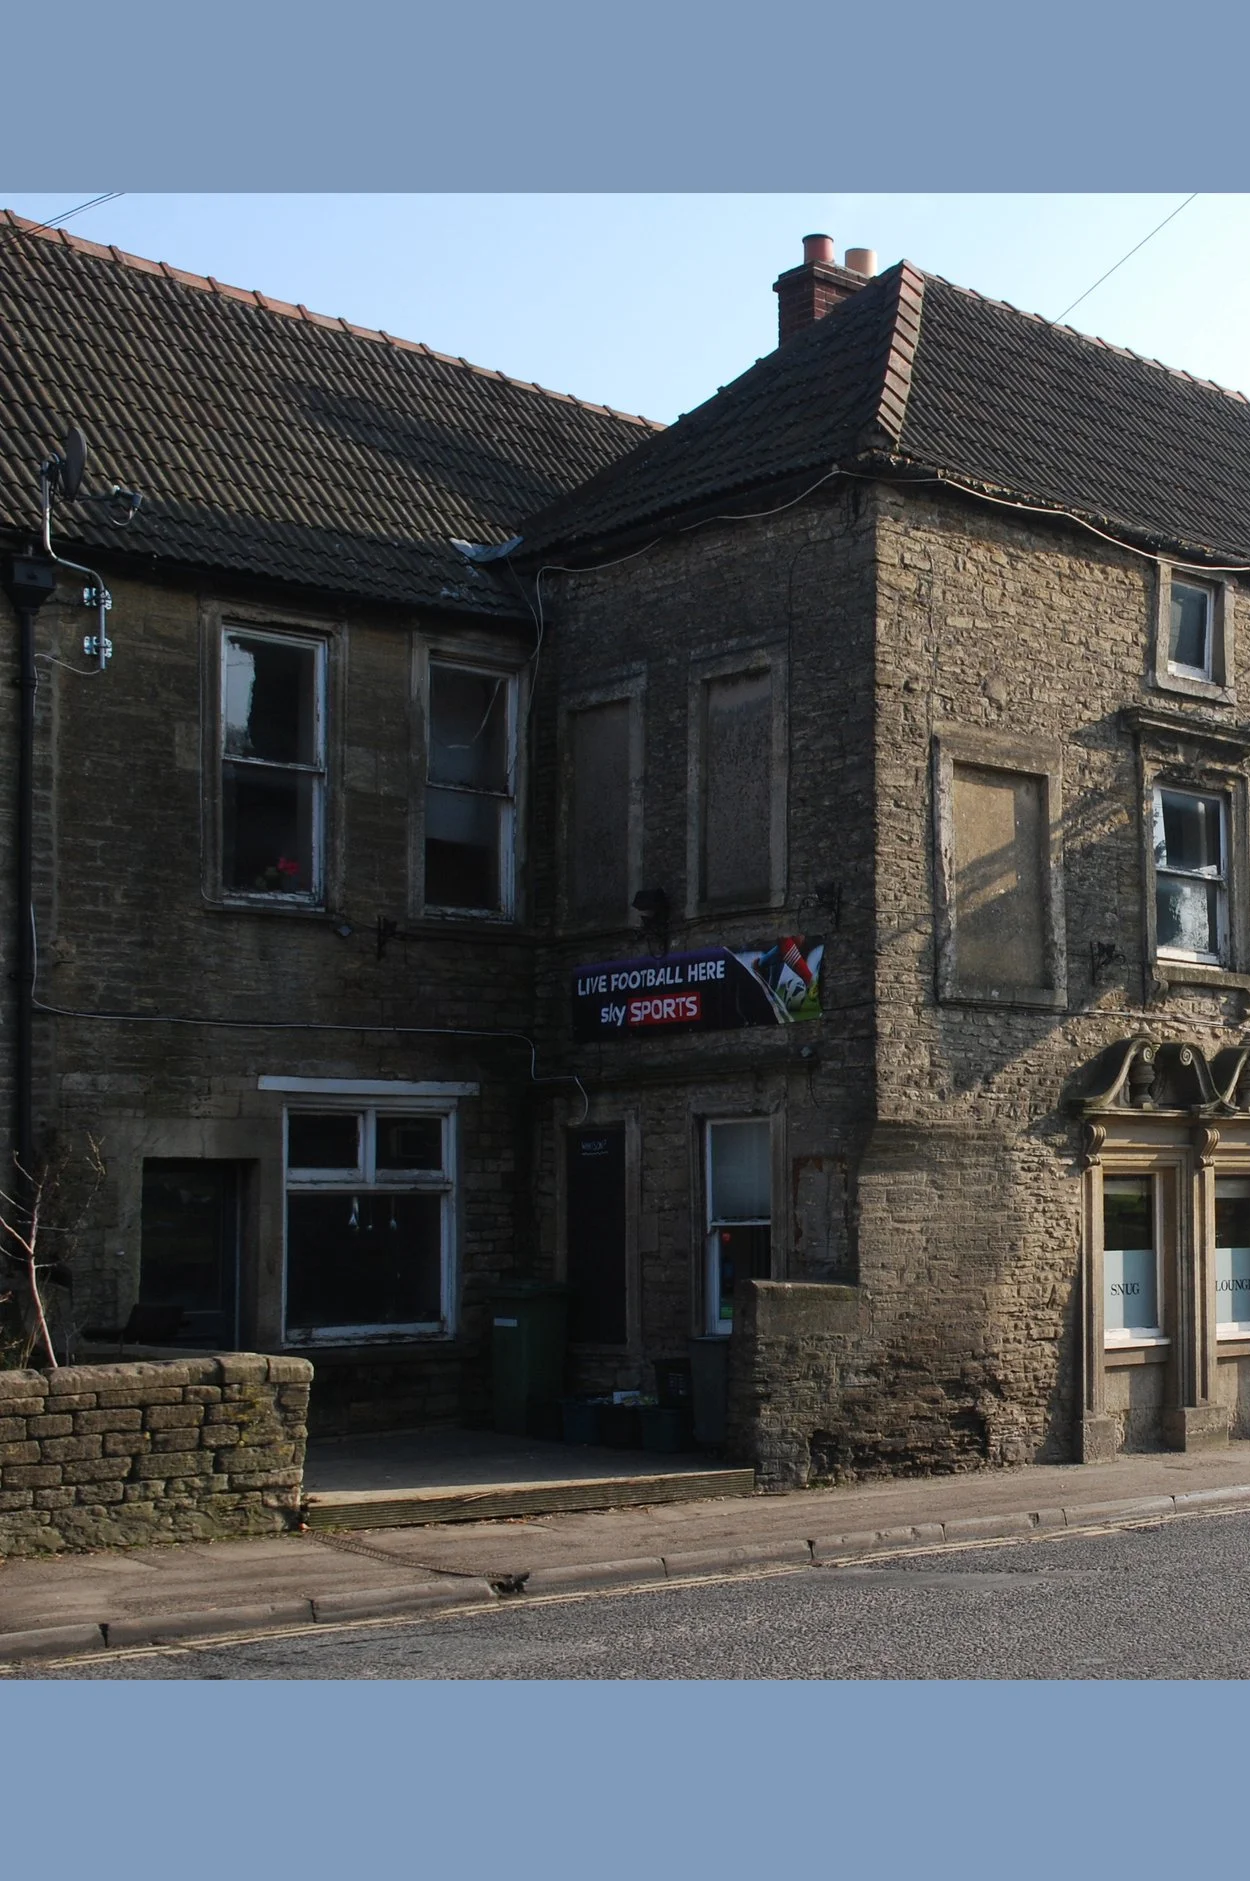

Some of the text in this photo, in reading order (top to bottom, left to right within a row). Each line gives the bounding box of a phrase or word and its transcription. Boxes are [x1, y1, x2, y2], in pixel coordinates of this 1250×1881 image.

[577, 960, 726, 997] LIVE FOOTBALL HERE
[600, 995, 698, 1027] sky SPORTS
[1110, 1282, 1140, 1297] SNUG
